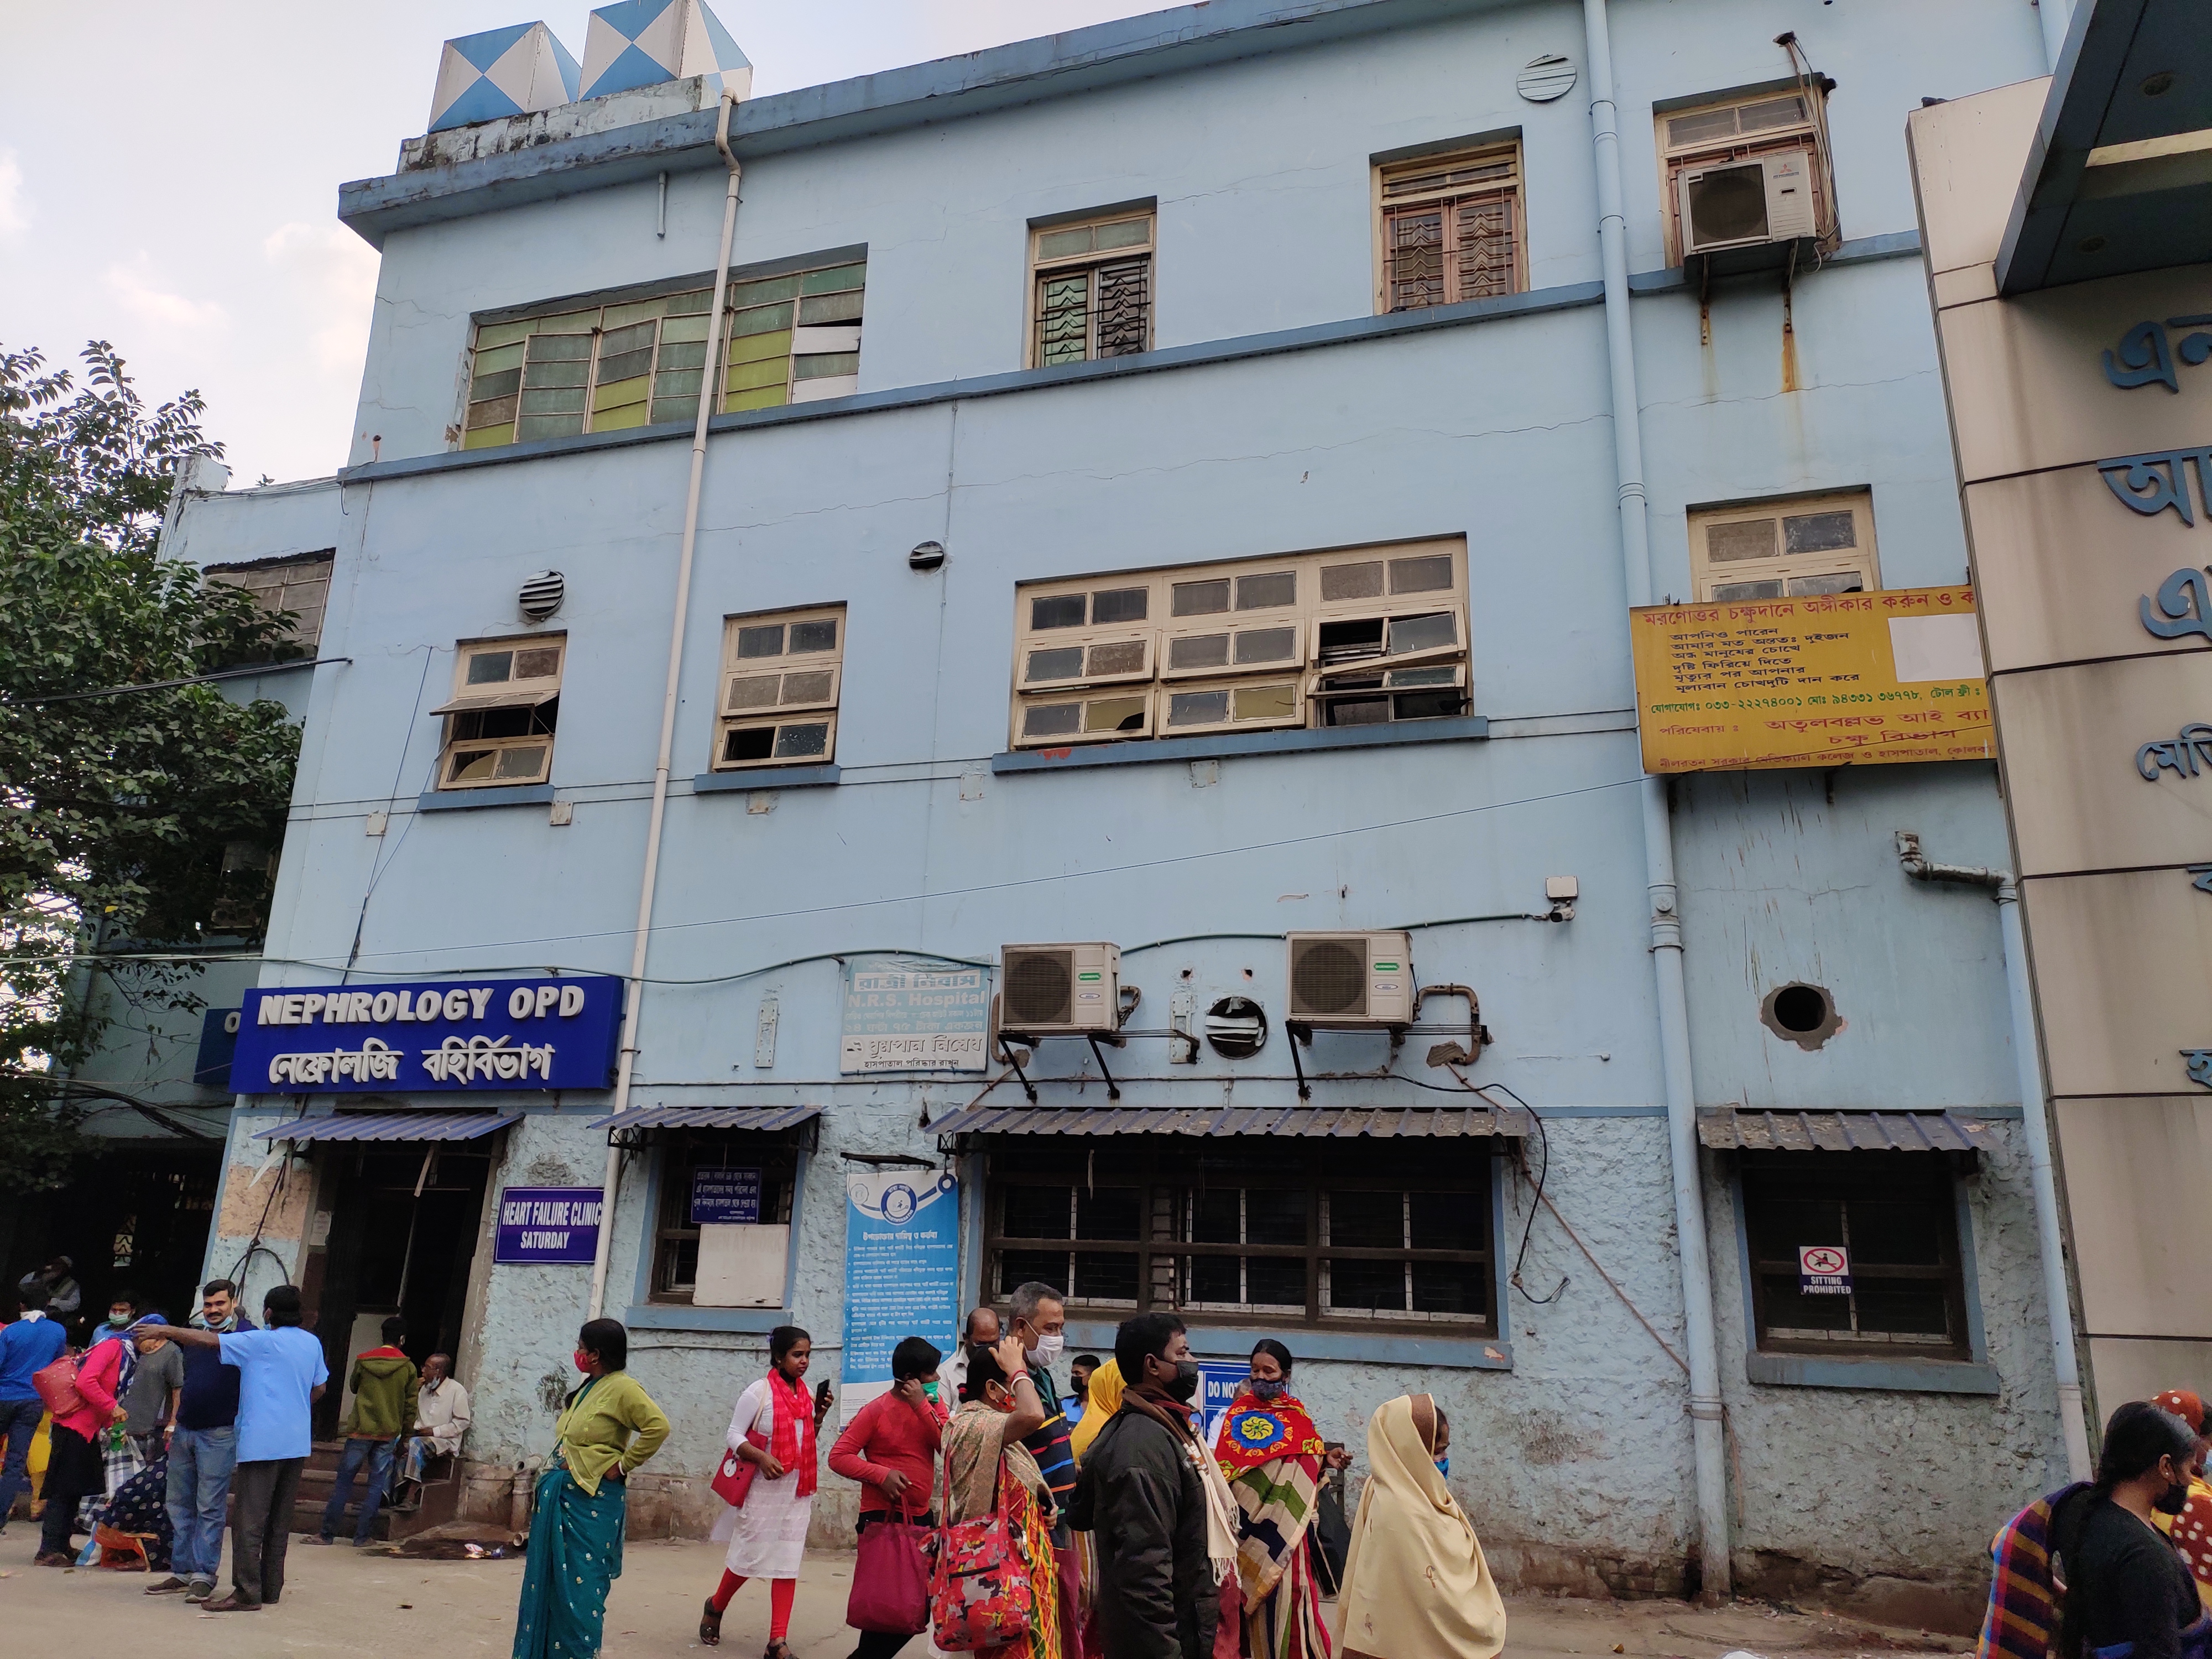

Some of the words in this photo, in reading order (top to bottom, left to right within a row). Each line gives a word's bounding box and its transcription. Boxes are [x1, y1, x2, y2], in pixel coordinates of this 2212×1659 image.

[1642, 608, 1719, 626] মরণোত্তর
[1729, 603, 1794, 623] চক্ষুদানে
[1881, 594, 1929, 609] করুন
[1936, 593, 1952, 606] ও
[1668, 630, 1728, 641] আপনিও
[1735, 628, 1778, 637] পারেন
[1670, 641, 1714, 650] আমার
[1804, 632, 1849, 644] দুইজন
[1748, 666, 1806, 676] আপনার
[1757, 657, 1793, 667] দিতে
[257, 988, 494, 1025] NEPHROLOGY
[508, 985, 585, 1019] OPD
[848, 993, 902, 1008] N.R.S.
[909, 990, 985, 1009] Hospital
[268, 1037, 404, 1084] নেফ্রোলজি
[421, 1034, 555, 1085] বহির্বিভাগ
[502, 1202, 533, 1225] HEART
[531, 1202, 570, 1226] FAILURE
[570, 1202, 602, 1227] CLINIC
[520, 1231, 570, 1249] SATURDAY
[1811, 1276, 1842, 1285] SITTING
[1803, 1285, 1851, 1295] PROHIBITED
[1208, 1381, 1220, 1398] DO
[1222, 1381, 1238, 1399] NO
